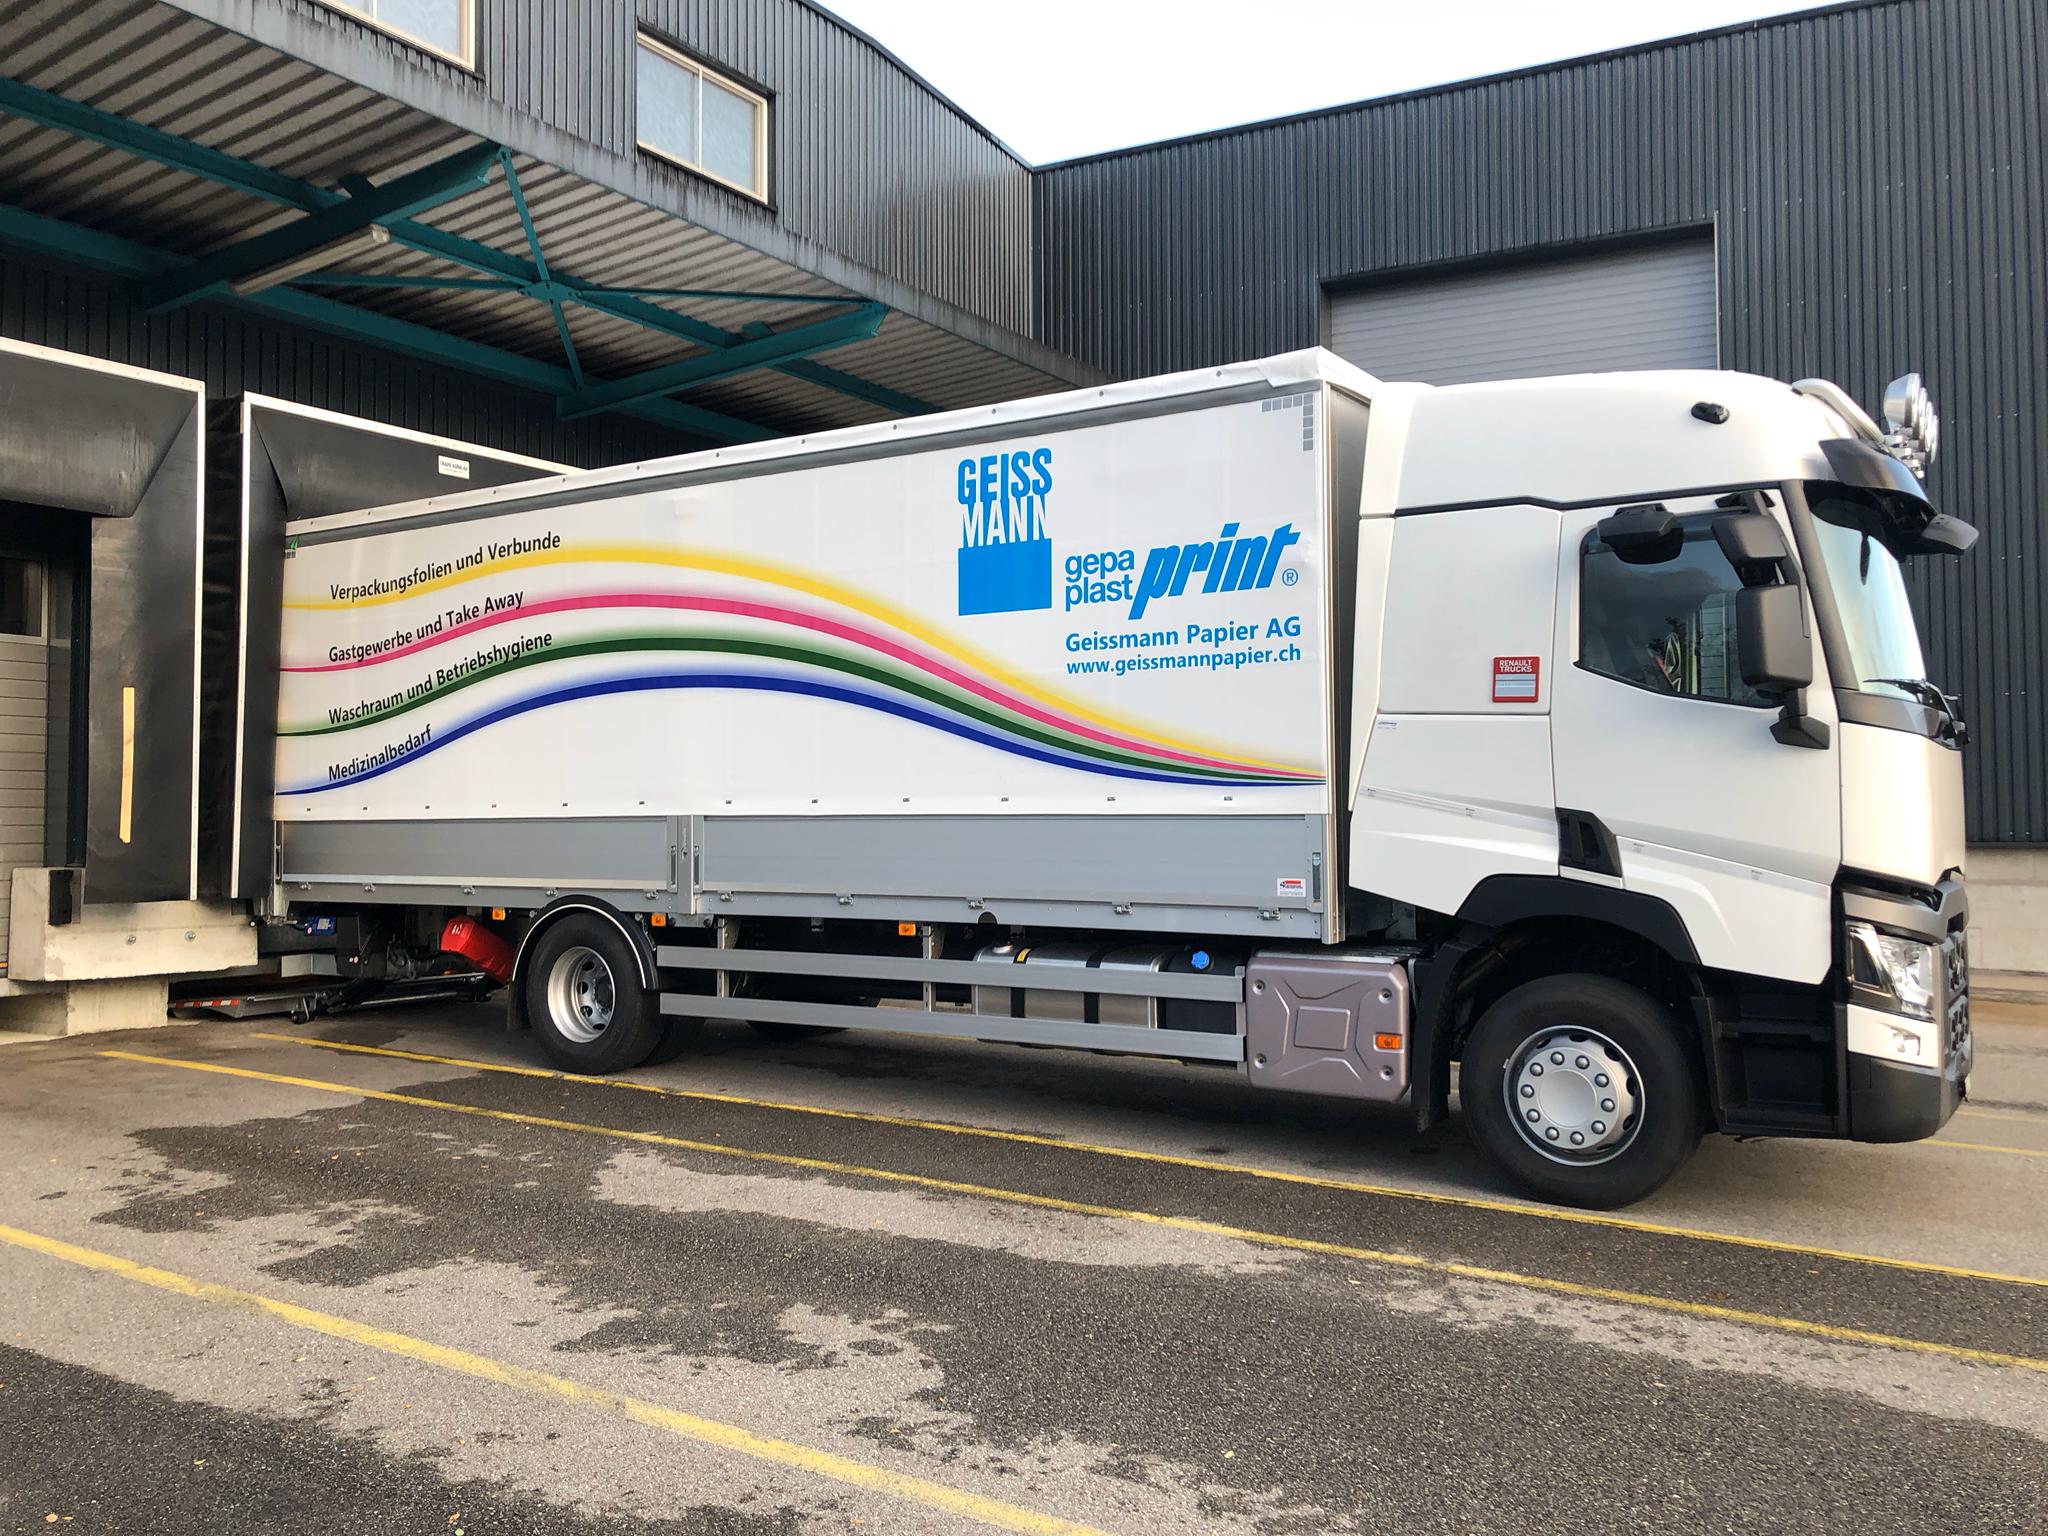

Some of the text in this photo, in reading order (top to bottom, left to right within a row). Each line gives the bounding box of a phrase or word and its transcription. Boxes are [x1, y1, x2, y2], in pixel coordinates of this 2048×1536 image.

[958, 448, 1052, 505] GEISS
[962, 494, 1047, 549] MANN
[330, 531, 560, 603] Verpackungsfolien und Verbunde
[1065, 549, 1135, 583] gepa
[1065, 574, 1134, 612] plast
[1128, 522, 1301, 620] print
[329, 590, 524, 663] Gastgewerbe und Take Away
[1065, 616, 1301, 652] Geissmann Papier AG
[329, 633, 553, 725] Waschraum und Betriebshygiene
[1067, 644, 1301, 676] www.geissmannpapier.ch
[1500, 659, 1532, 667] RENAULT
[328, 723, 432, 782] Medizinalbedarf
